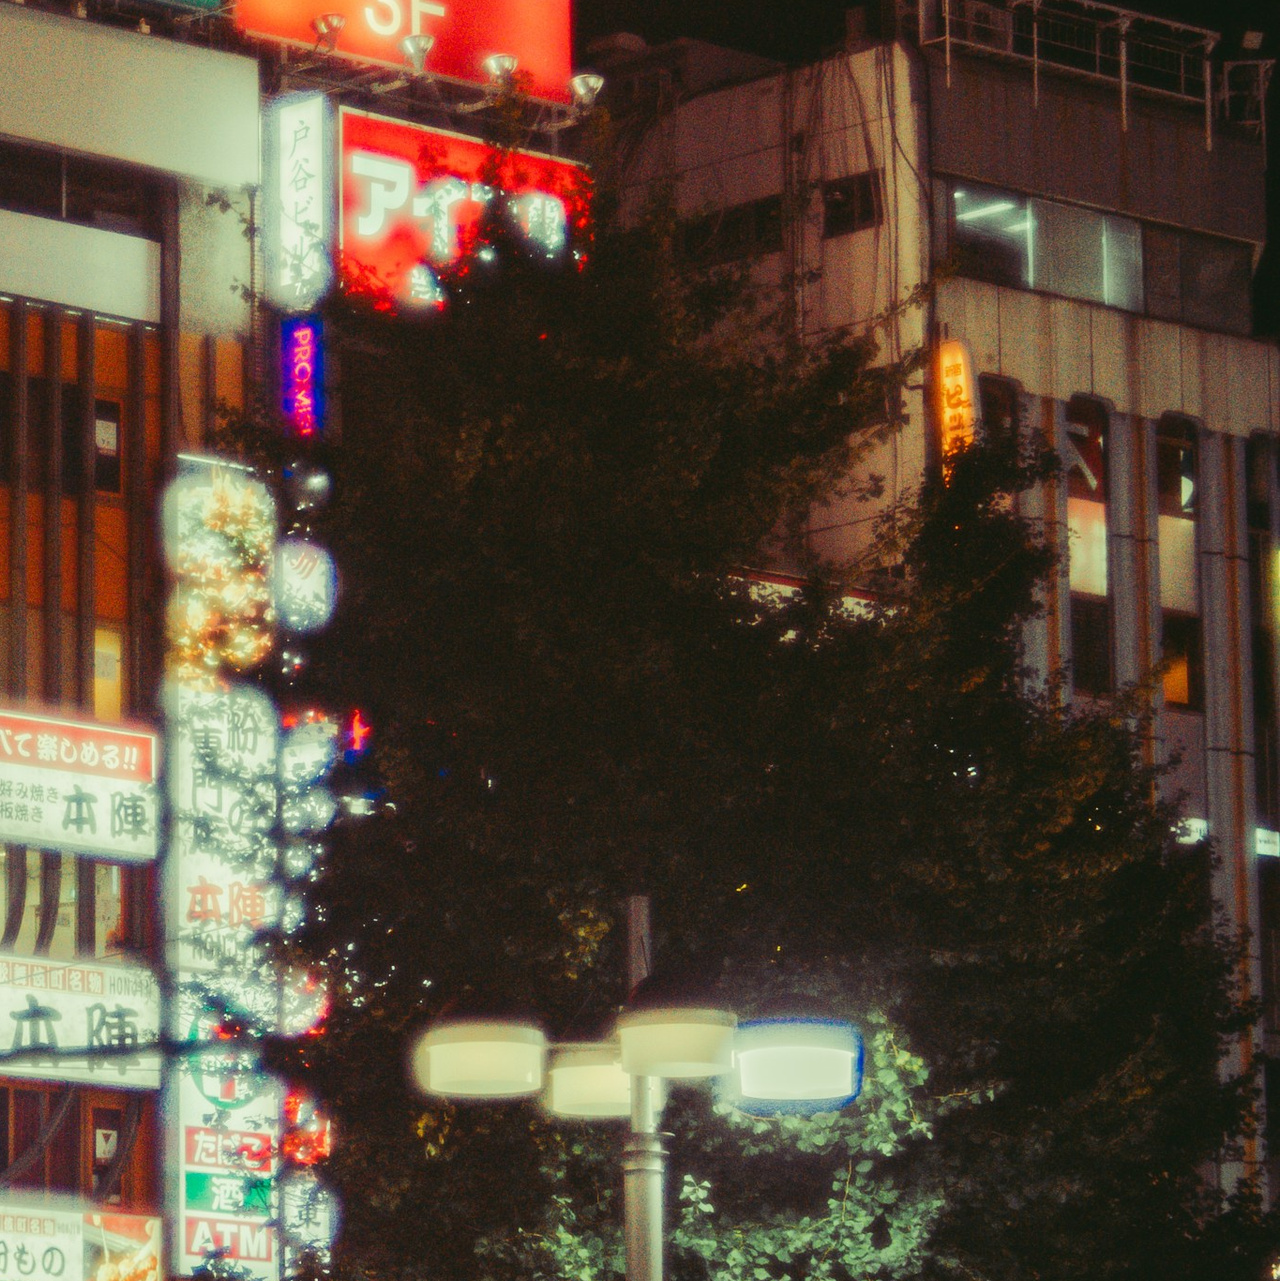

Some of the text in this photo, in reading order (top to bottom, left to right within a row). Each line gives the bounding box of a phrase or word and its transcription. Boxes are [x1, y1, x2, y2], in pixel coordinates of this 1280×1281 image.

[62, 784, 152, 842] 本陣
[10, 993, 141, 1076] 本陣
[211, 1177, 243, 1211] 酒
[190, 1220, 268, 1259] ATM
